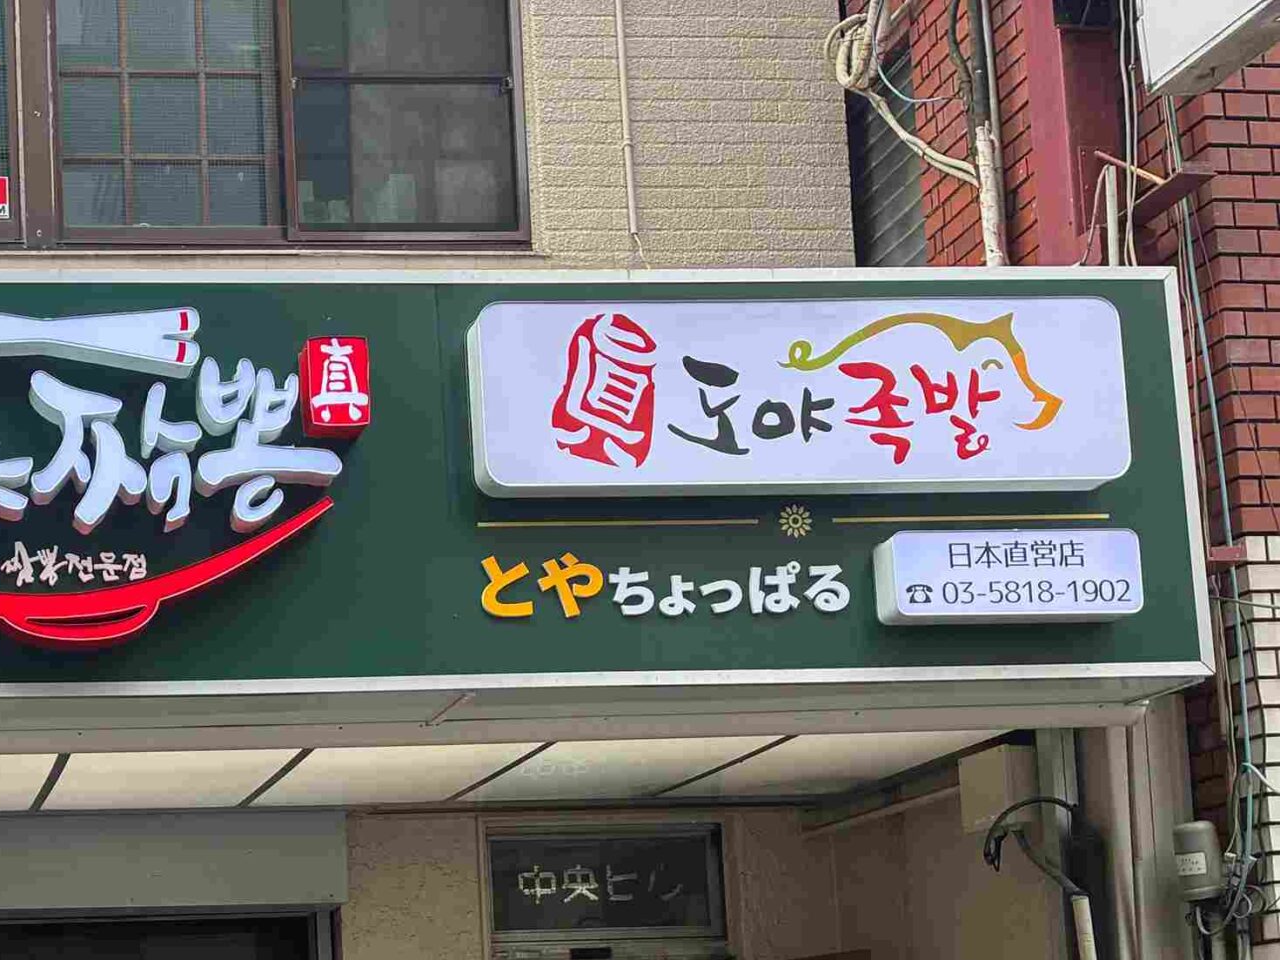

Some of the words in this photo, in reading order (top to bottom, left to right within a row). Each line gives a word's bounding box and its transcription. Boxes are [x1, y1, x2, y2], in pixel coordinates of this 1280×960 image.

[948, 541, 1086, 570] 日本直営店
[941, 578, 1133, 606] 03-5818-1902
